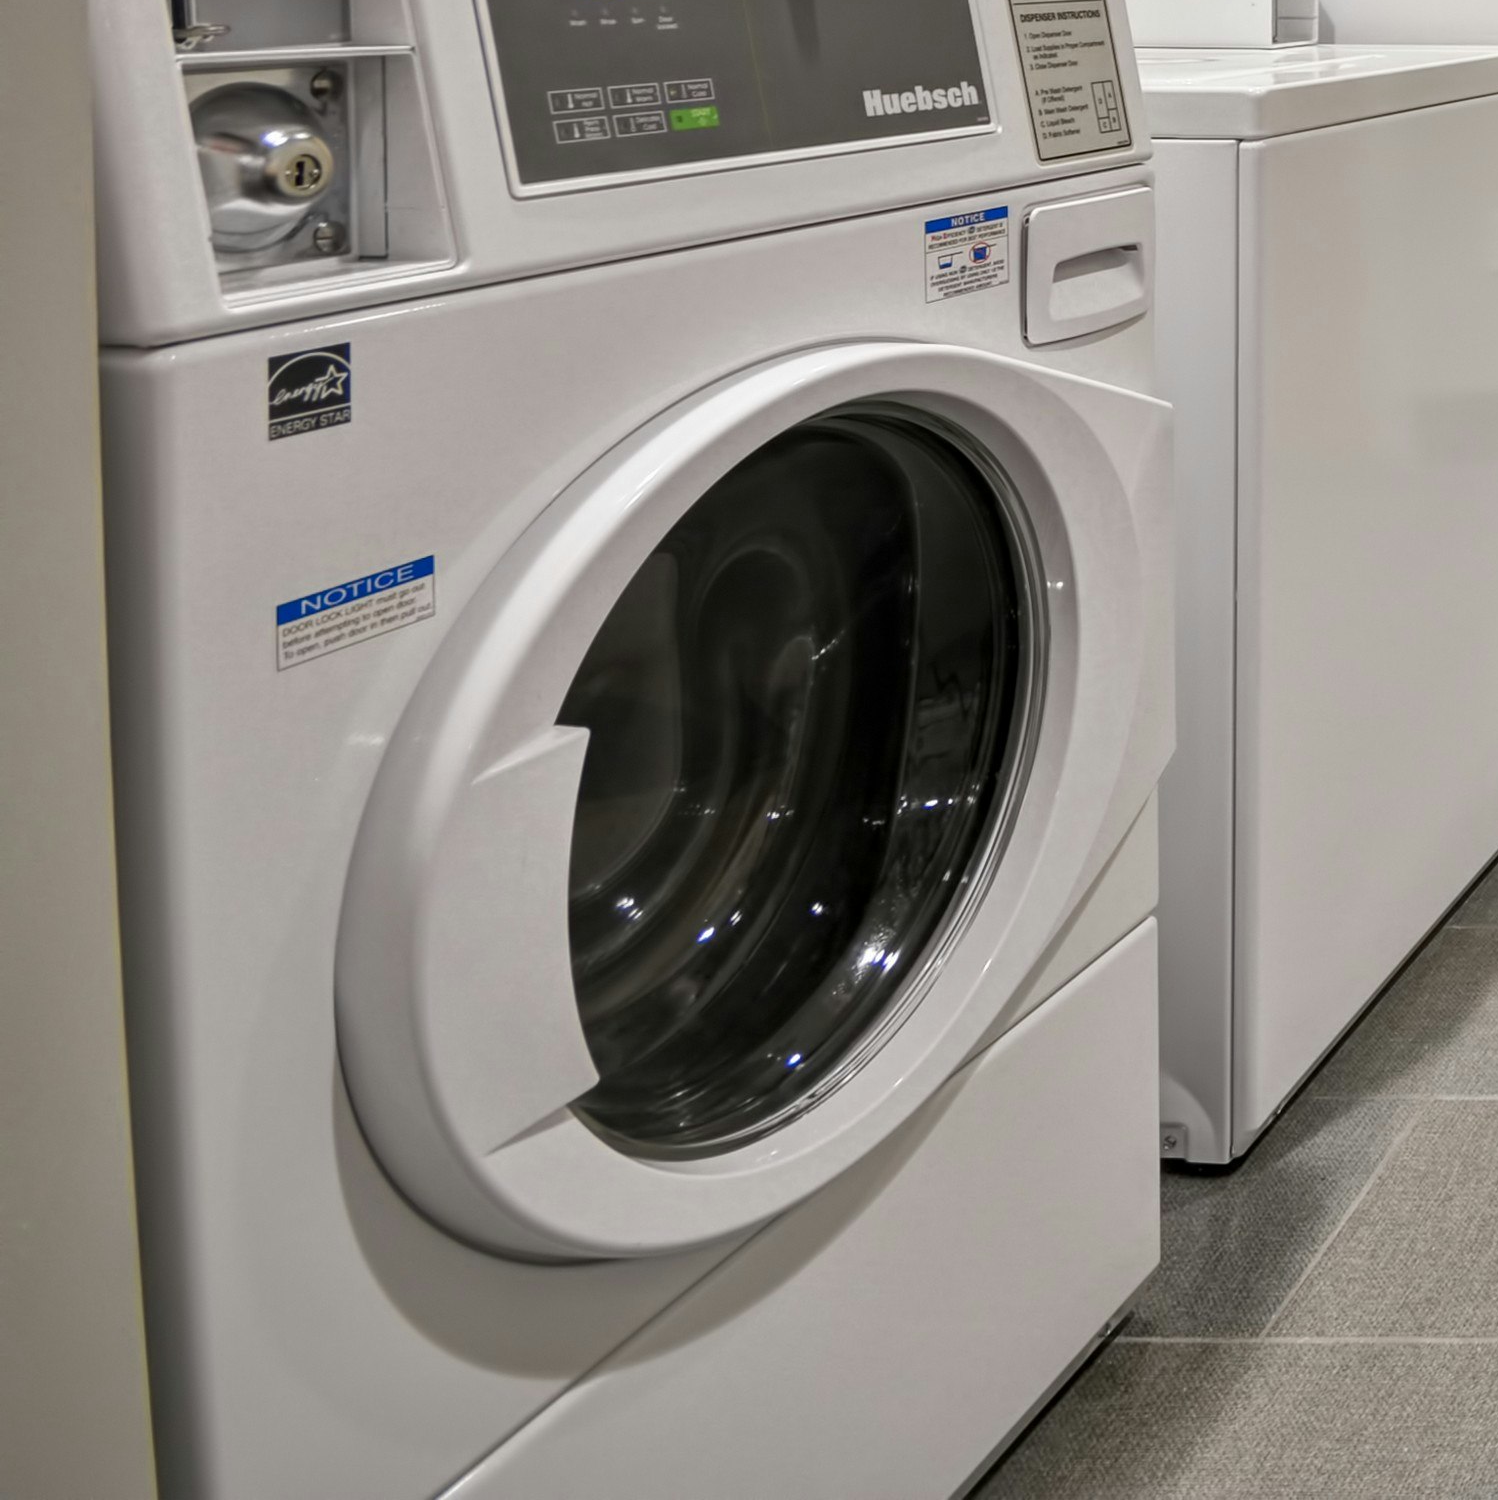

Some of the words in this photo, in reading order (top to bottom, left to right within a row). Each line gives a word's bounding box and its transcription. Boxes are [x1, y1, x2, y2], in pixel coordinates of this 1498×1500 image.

[1019, 12, 1056, 22] DISPENSER
[1056, 9, 1100, 19] INSTRUCTIONS
[863, 81, 979, 117] Huebsch
[951, 212, 985, 227] NOTICE
[270, 416, 318, 438] ENERGY
[320, 409, 351, 426] STAR
[301, 564, 414, 615] NOTICE
[282, 619, 313, 637] DOOR
[315, 610, 343, 625] LOCK
[345, 599, 374, 615] LIGHT
